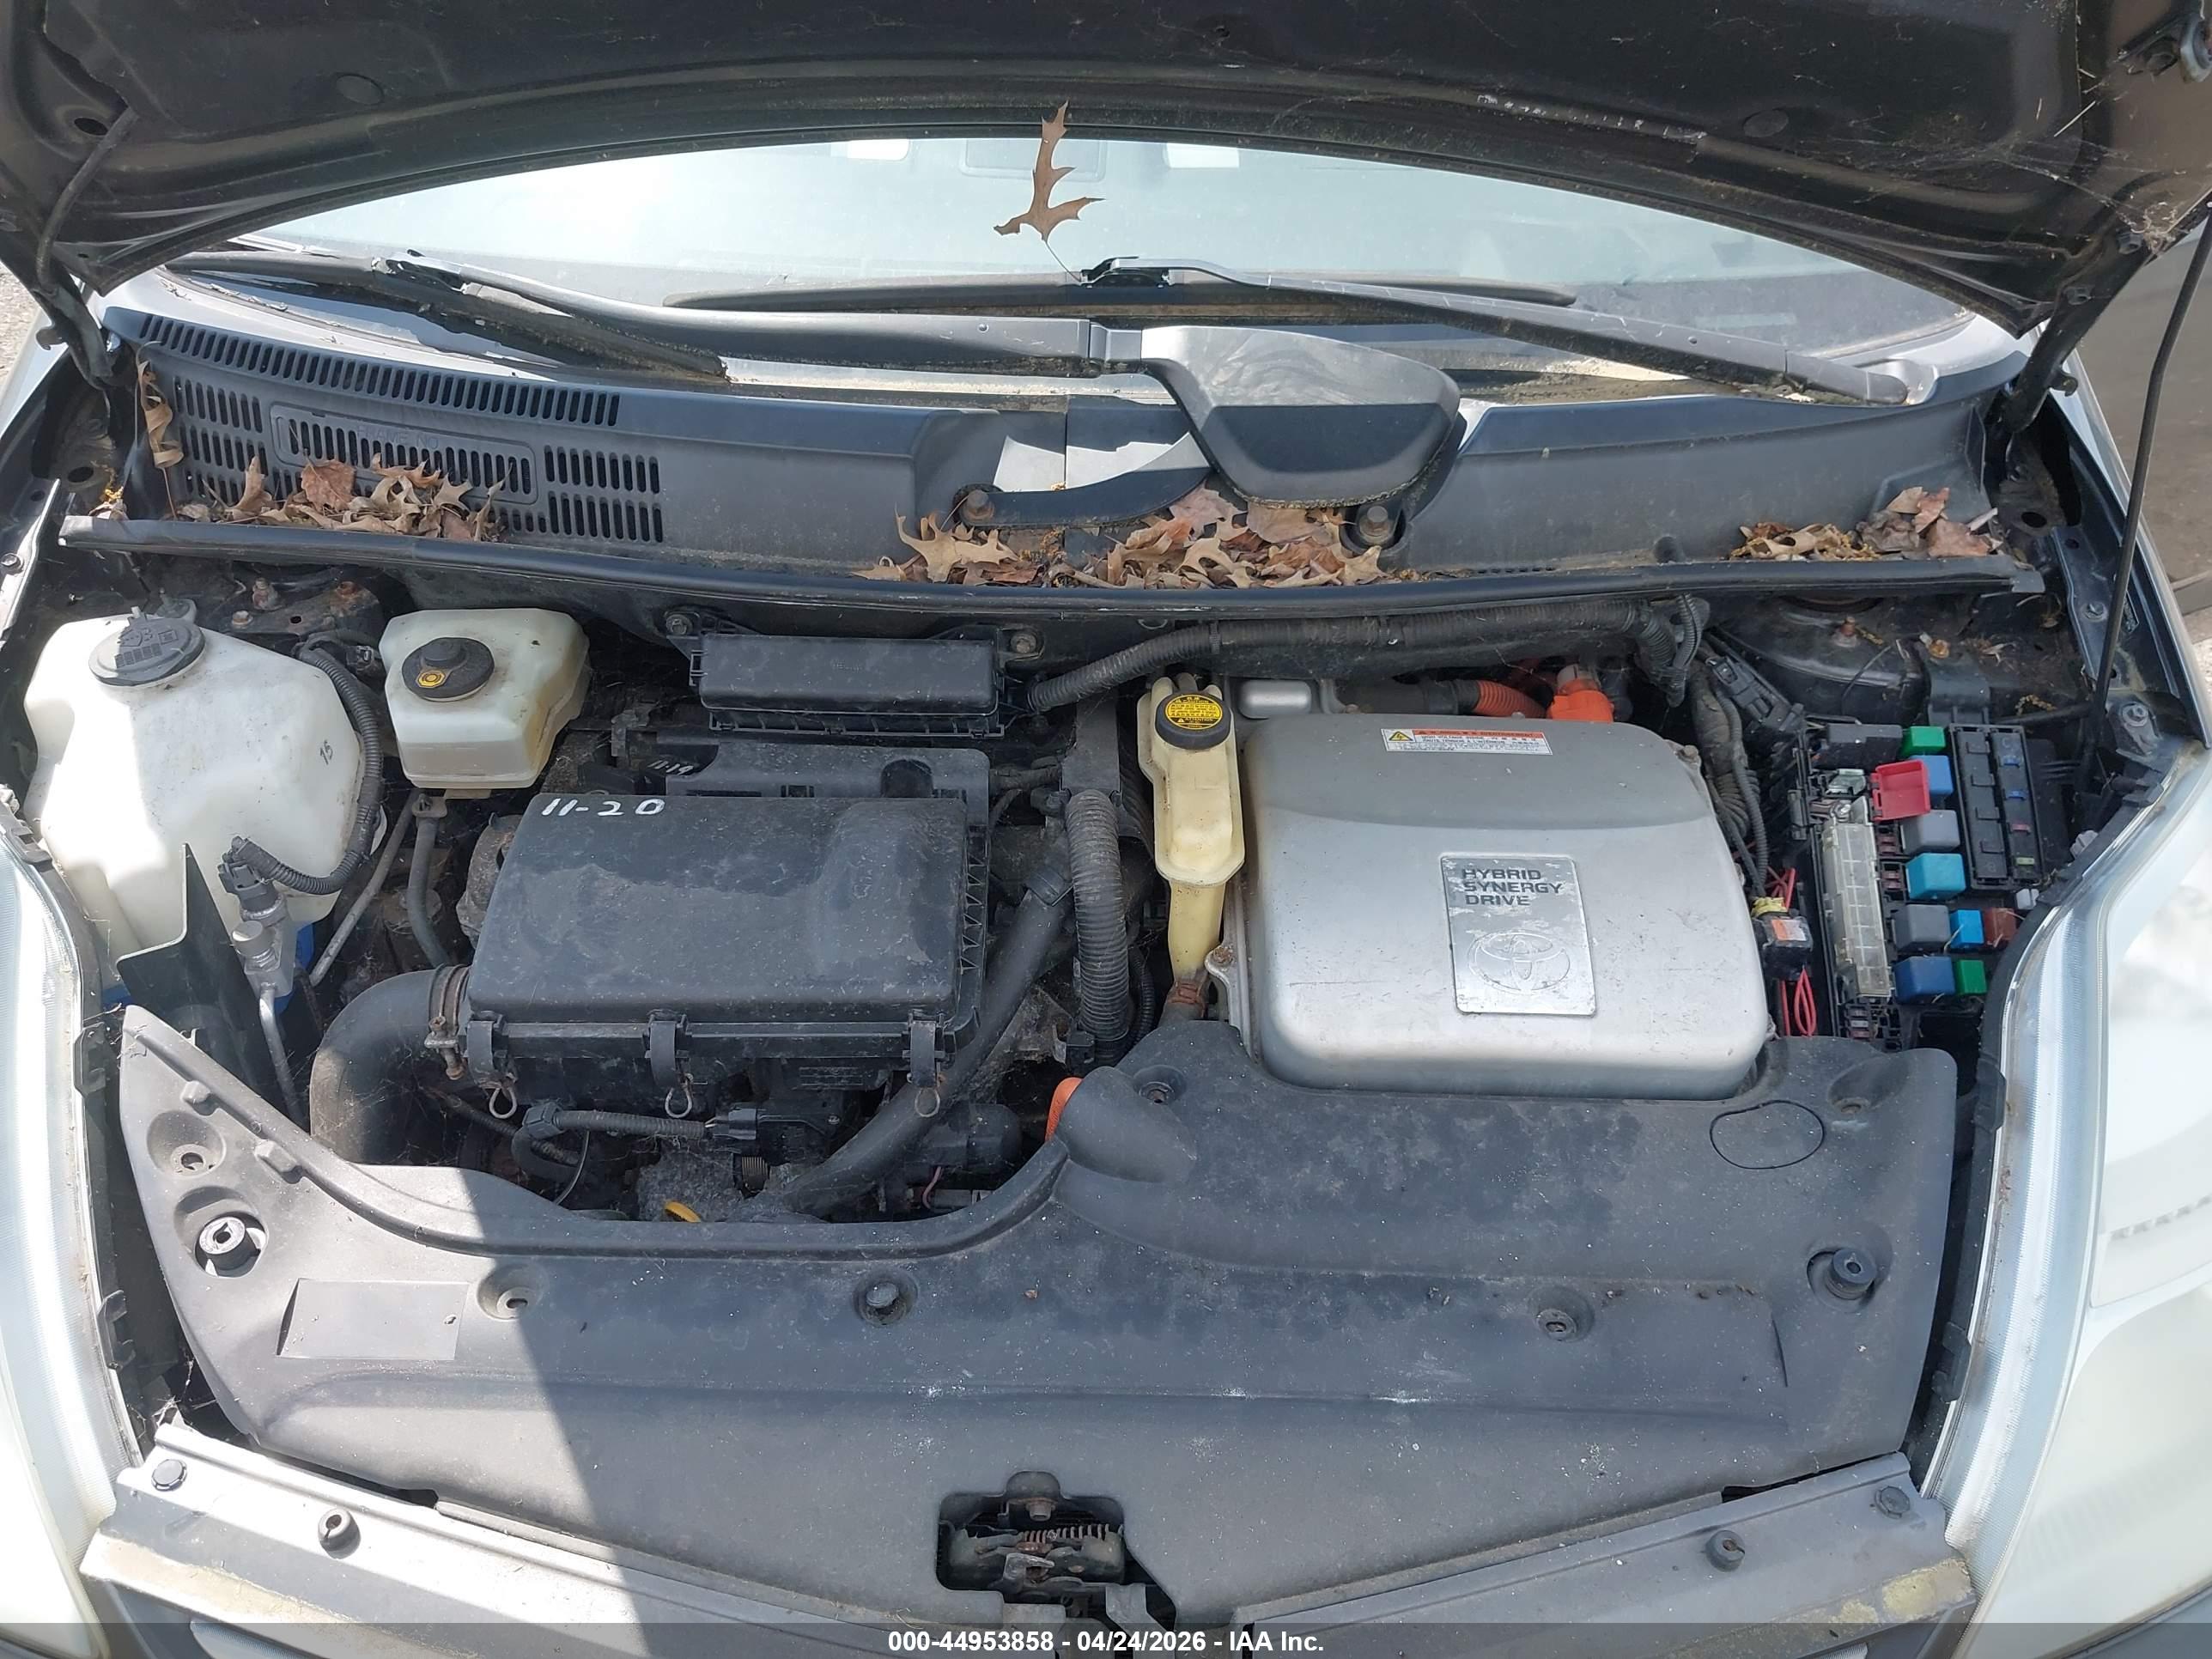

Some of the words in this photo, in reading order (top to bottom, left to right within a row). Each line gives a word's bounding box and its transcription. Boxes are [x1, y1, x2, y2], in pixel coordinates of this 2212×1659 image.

[541, 798, 665, 817] 11-20
[1462, 868, 1541, 880] HYBRID
[1463, 881, 1563, 894] SYNERGY
[1465, 894, 1531, 906] DRIVE
